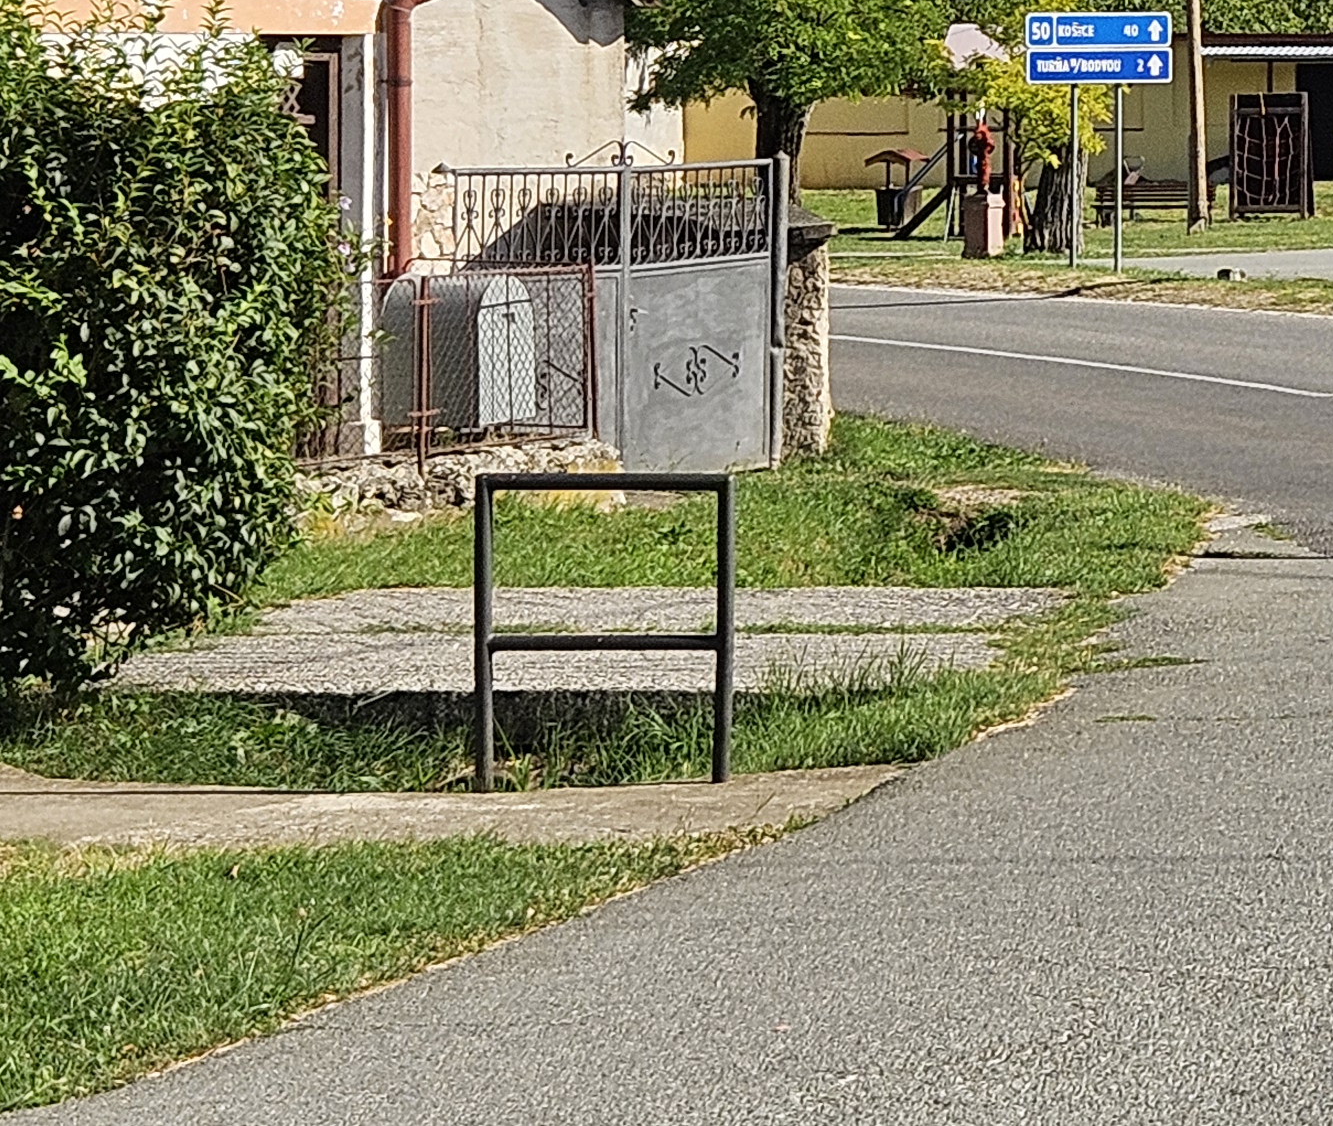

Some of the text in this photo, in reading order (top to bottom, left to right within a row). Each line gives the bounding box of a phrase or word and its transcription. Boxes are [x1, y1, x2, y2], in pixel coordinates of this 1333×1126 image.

[1031, 22, 1050, 40] 50
[1123, 25, 1139, 37] 40
[1136, 59, 1144, 73] 2
